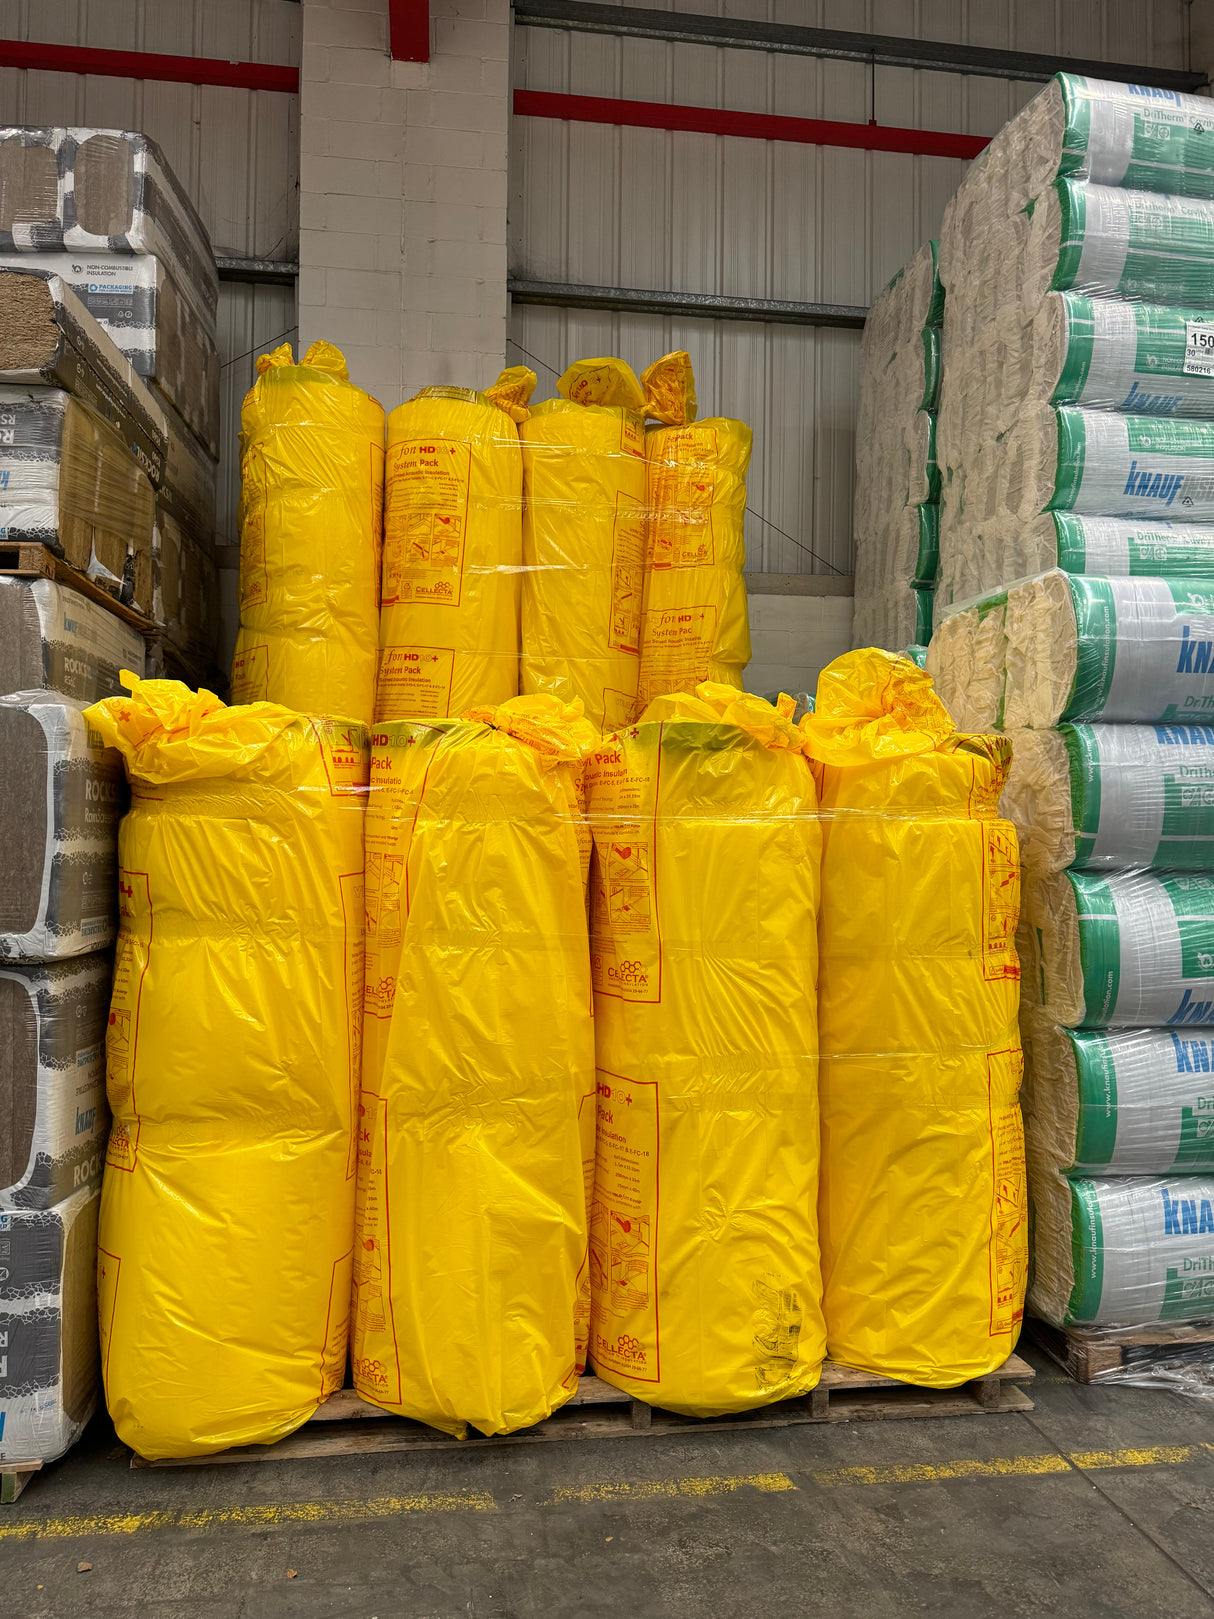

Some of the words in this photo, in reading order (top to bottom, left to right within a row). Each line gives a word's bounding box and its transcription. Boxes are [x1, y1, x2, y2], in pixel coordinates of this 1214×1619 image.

[1186, 348, 1195, 356] 30
[419, 458, 439, 467] Pack
[1123, 460, 1184, 507] KNAUF
[415, 586, 453, 595] CELLECTA
[404, 666, 421, 675] Pack
[371, 755, 392, 770] Pack
[595, 751, 621, 764] Pack
[597, 1104, 613, 1124] Pack
[597, 1334, 646, 1361] CELLECTA
